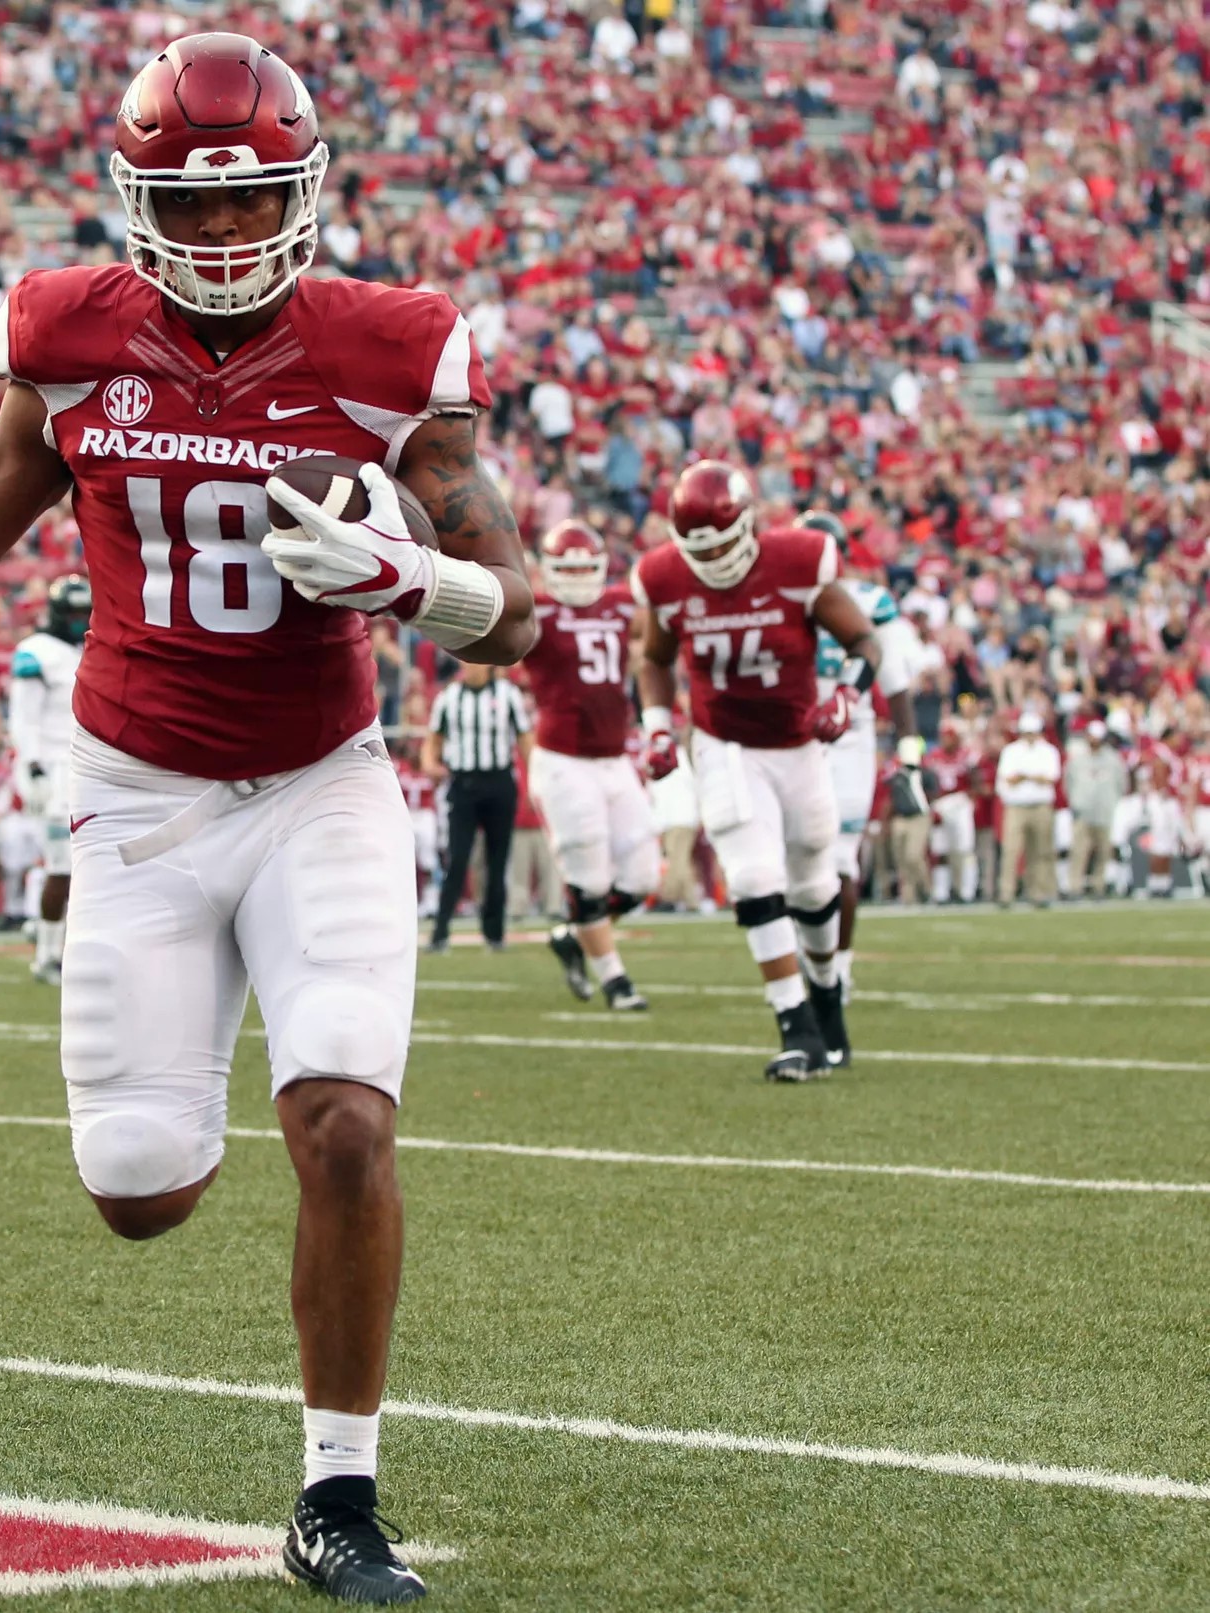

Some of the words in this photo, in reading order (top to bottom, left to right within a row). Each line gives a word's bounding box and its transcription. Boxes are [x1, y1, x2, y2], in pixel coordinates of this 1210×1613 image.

[107, 378, 149, 422] SEC
[77, 426, 337, 472] RAZORBAC
[126, 475, 283, 634] 18
[575, 630, 622, 685] 51
[693, 629, 783, 691] 74
